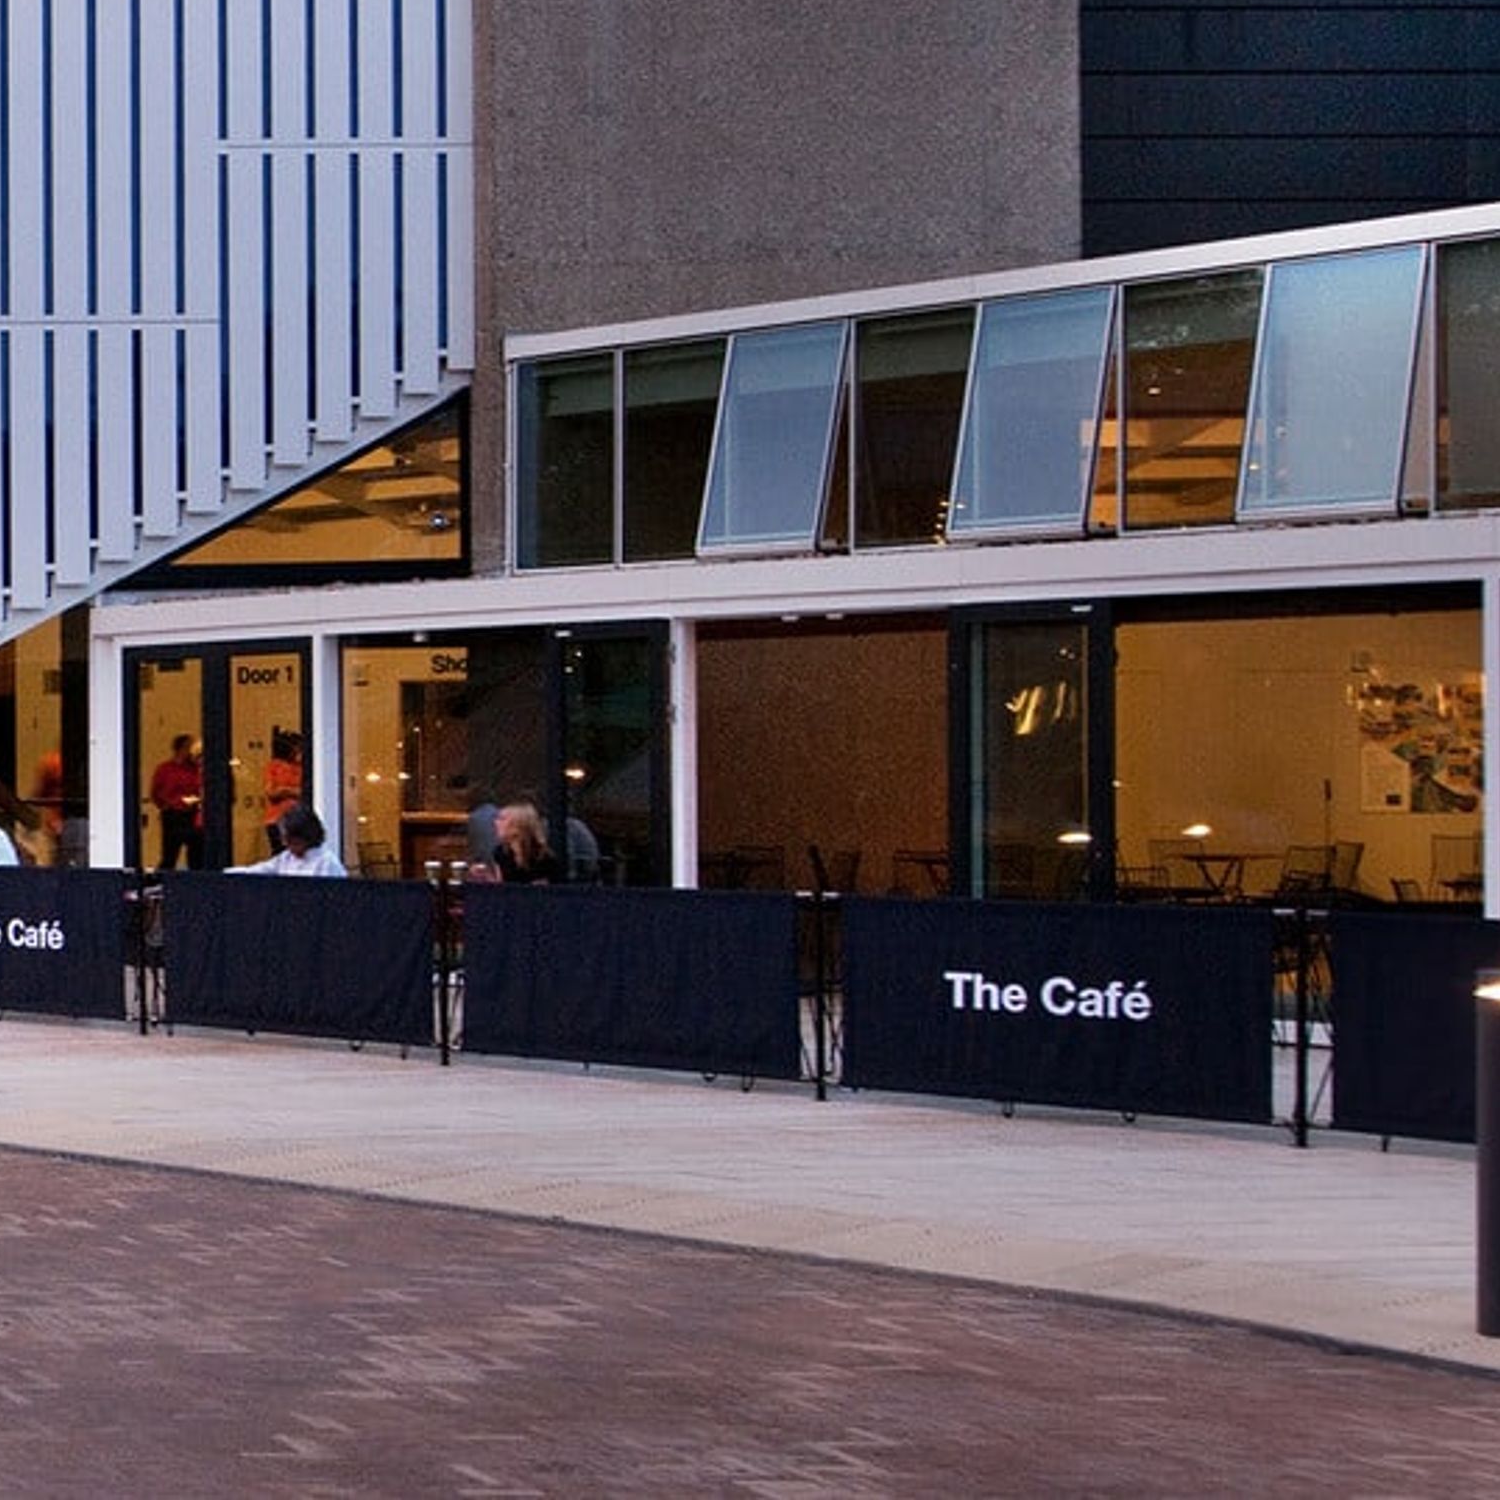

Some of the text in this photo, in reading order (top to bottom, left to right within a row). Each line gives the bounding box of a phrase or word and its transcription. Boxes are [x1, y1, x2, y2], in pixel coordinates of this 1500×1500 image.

[236, 665, 293, 684] Door 1
[8, 918, 64, 950] Café
[944, 971, 1152, 1020] The Café
